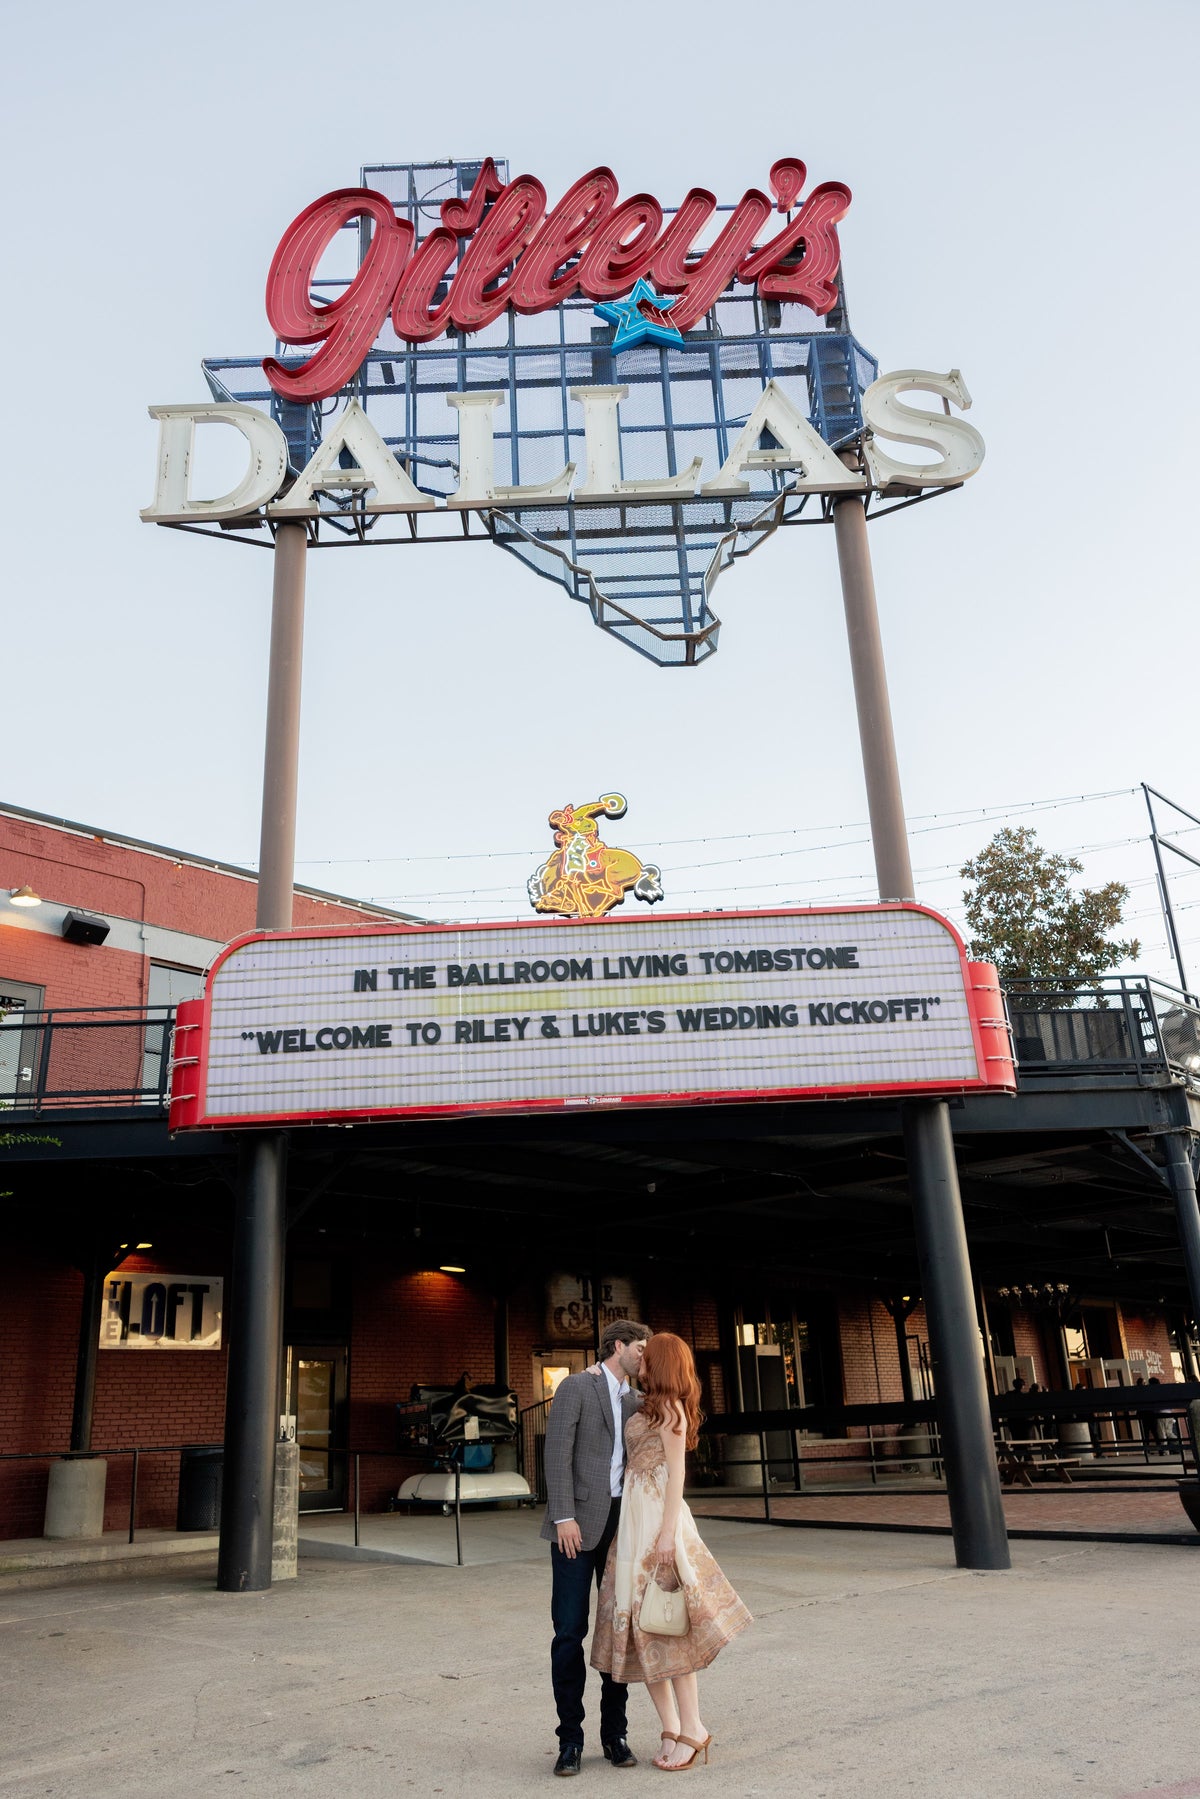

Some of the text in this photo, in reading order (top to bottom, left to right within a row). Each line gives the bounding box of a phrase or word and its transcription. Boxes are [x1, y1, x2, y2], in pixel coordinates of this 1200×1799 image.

[140, 369, 986, 523] DALLAS
[354, 947, 859, 992] IN THE BALLROOM LIVING TOMBSTONE
[406, 1021, 442, 1046] TO
[455, 1017, 530, 1044] RILEY
[541, 1015, 561, 1039] &
[572, 1010, 666, 1038] LUKE'S
[676, 1004, 799, 1032] WEDDING
[576, 1272, 613, 1302] TE
[120, 1281, 210, 1341] LOFT
